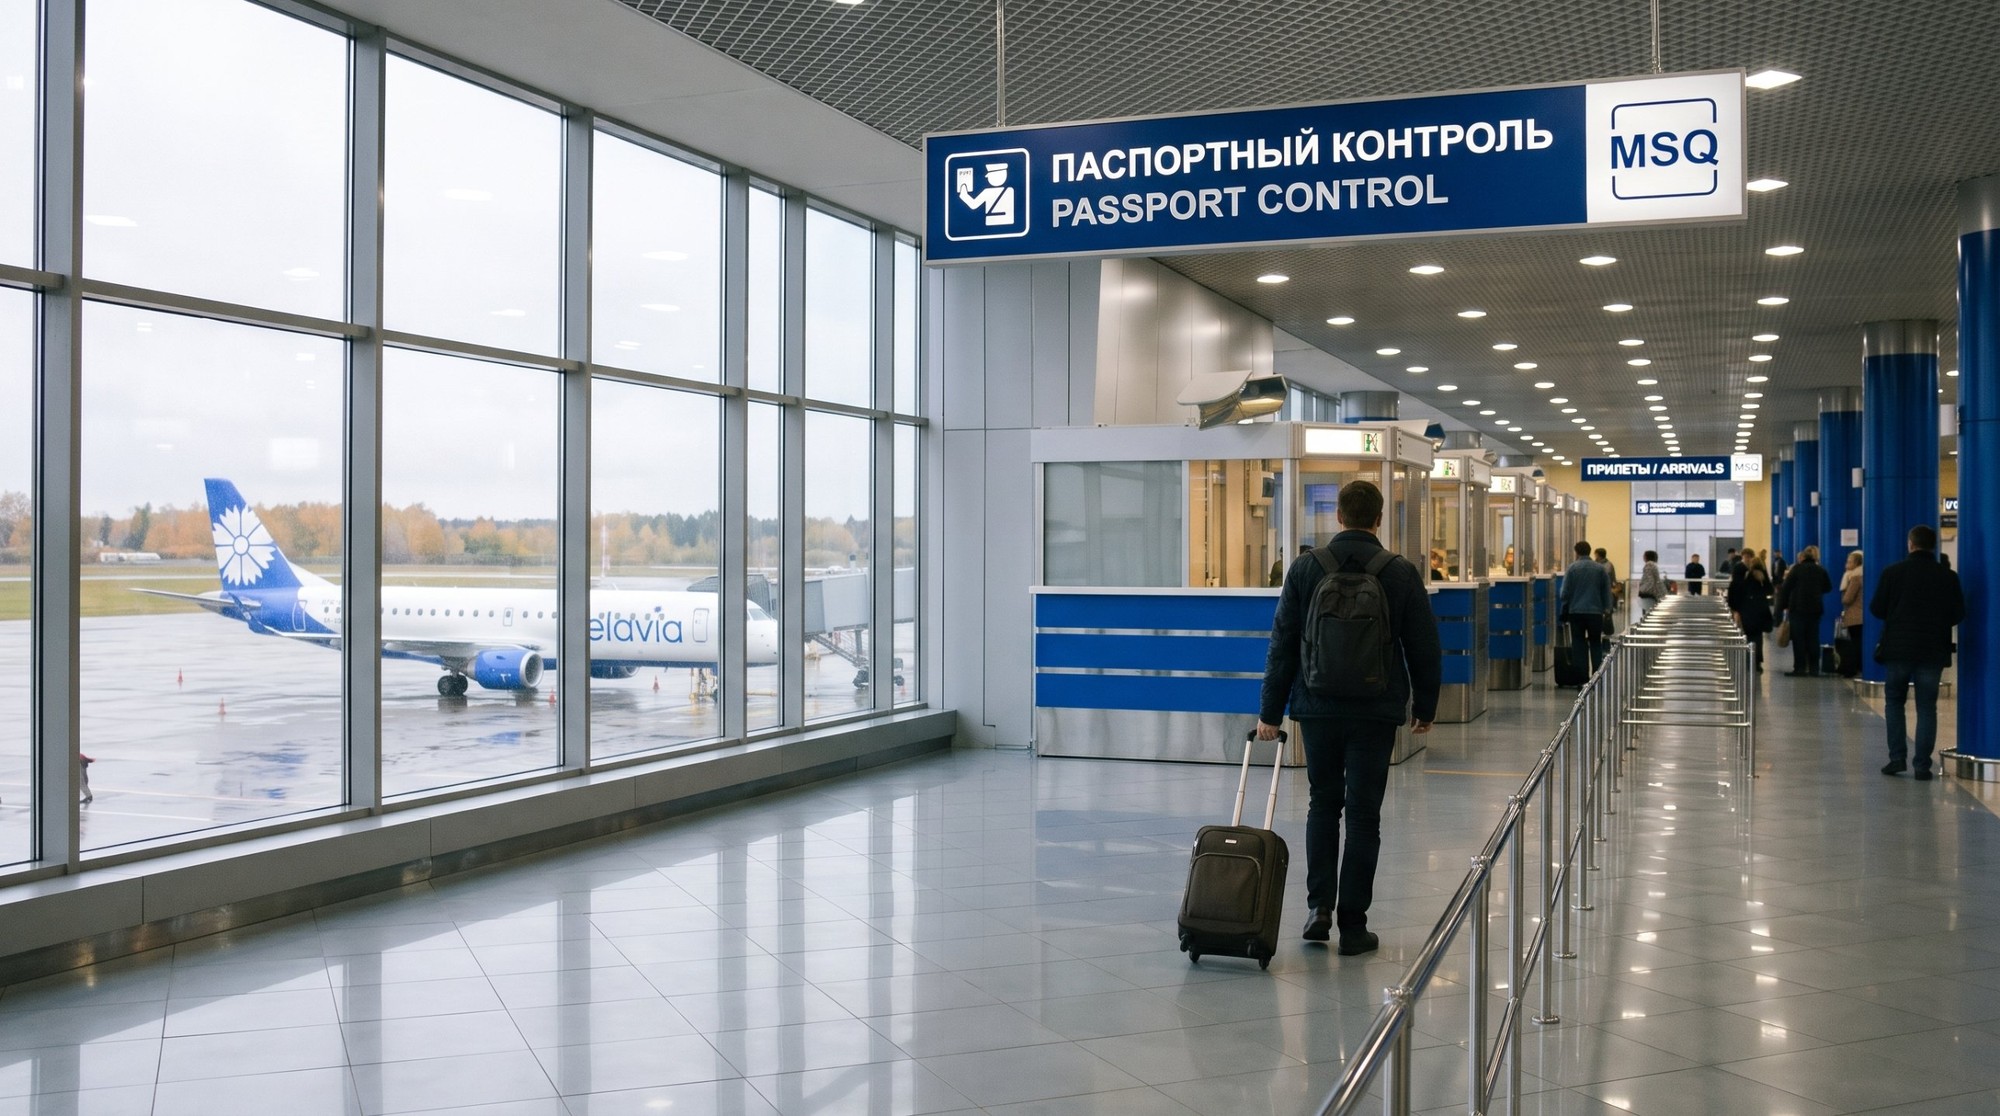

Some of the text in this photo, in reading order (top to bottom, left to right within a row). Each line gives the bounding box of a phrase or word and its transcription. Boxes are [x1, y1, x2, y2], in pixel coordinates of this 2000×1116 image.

[1052, 118, 1554, 184] ПАСПОРТНЫЙ КОНТРОЛЬ
[1610, 128, 1719, 170] MSQ
[1052, 174, 1449, 228] PASSPORT CONTROL
[1586, 463, 1651, 475] ПРИЛЕТЫ
[1659, 462, 1725, 475] ARRIVALS
[1735, 462, 1759, 472] MSQ
[589, 606, 682, 643] elavia
